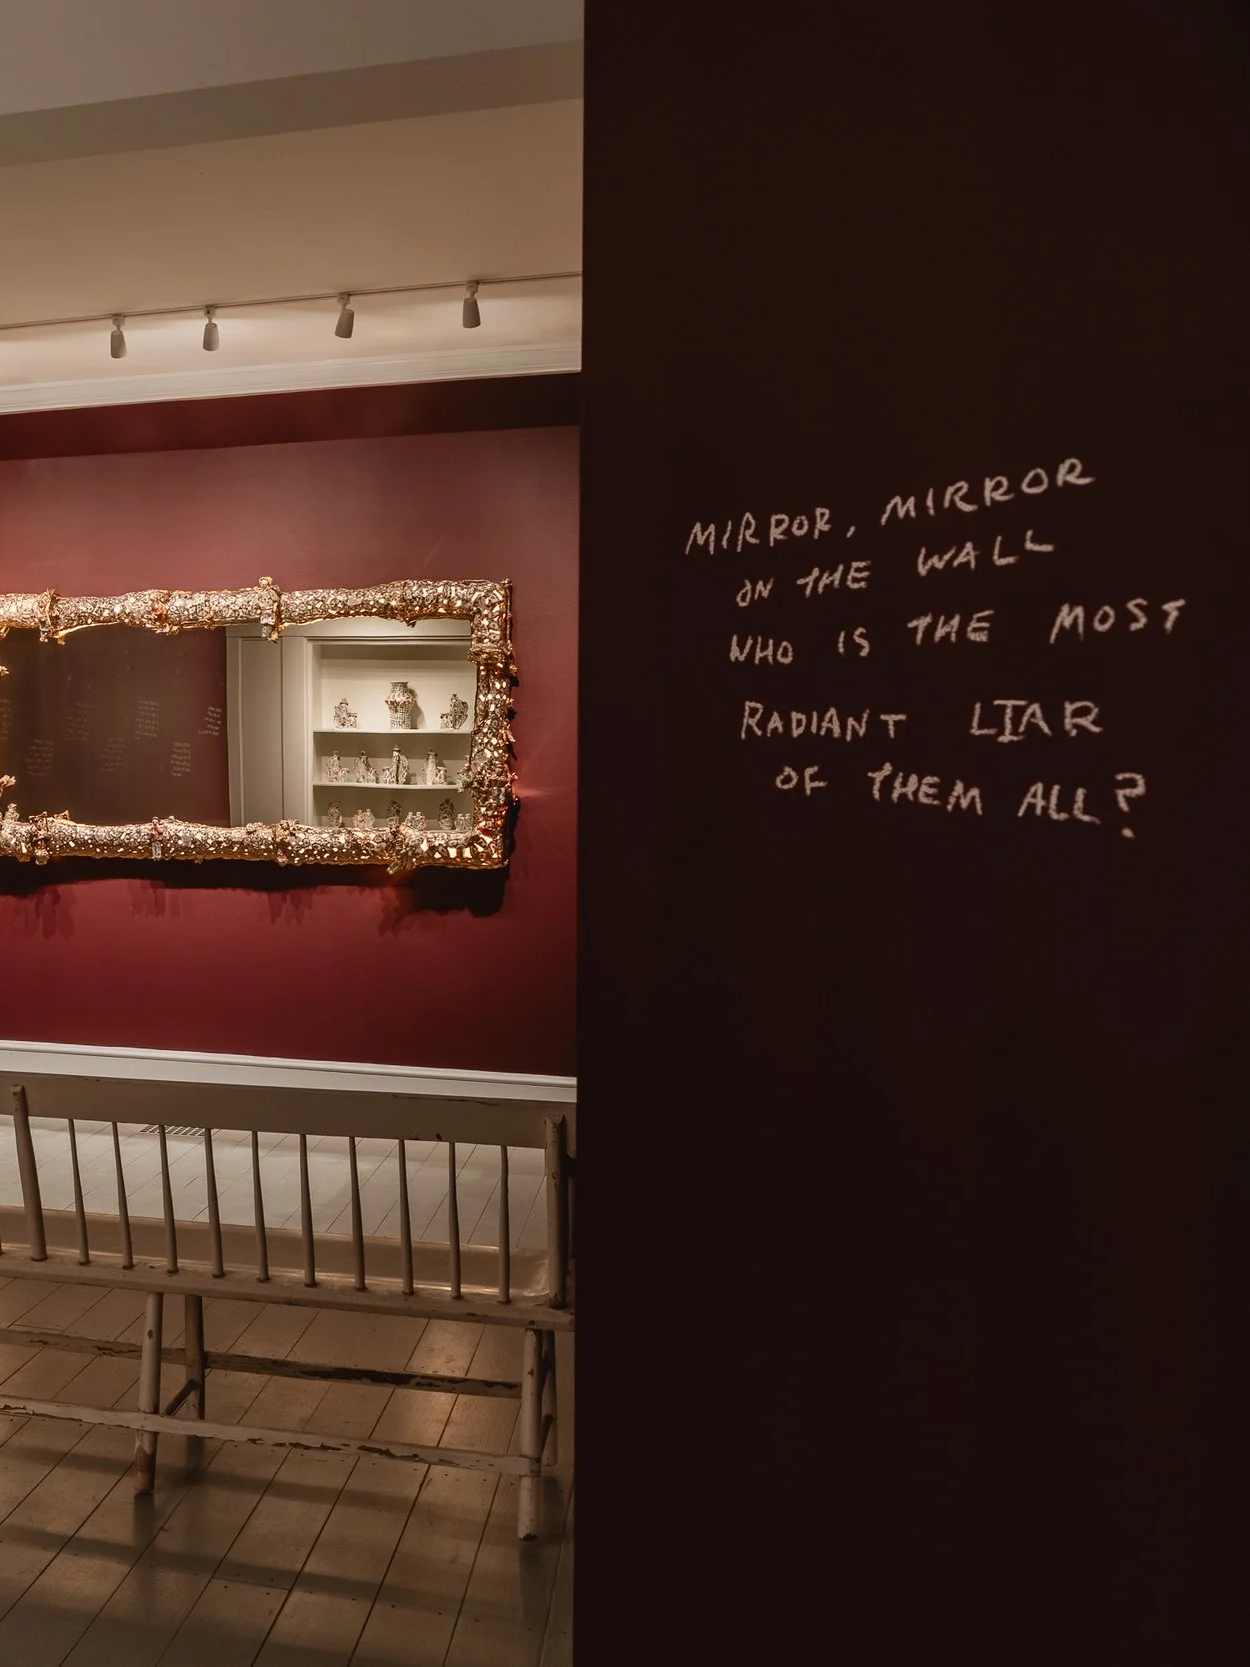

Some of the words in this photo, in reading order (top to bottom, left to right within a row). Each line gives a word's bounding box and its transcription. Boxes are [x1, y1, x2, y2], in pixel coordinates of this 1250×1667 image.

[686, 507, 855, 555] MIRROR,
[881, 458, 1094, 525] MIRROR
[736, 579, 773, 607] ON
[797, 561, 870, 597] THE
[918, 530, 1054, 576] WALL
[730, 635, 793, 664] WHO
[838, 627, 869, 656] IS
[907, 610, 994, 645] THE
[1050, 598, 1185, 643] MOST
[741, 701, 906, 741] RADIANT
[970, 700, 1102, 743] LIAR
[776, 766, 827, 796] OF
[868, 762, 982, 815] THEM
[1018, 773, 1145, 838] ALL?
